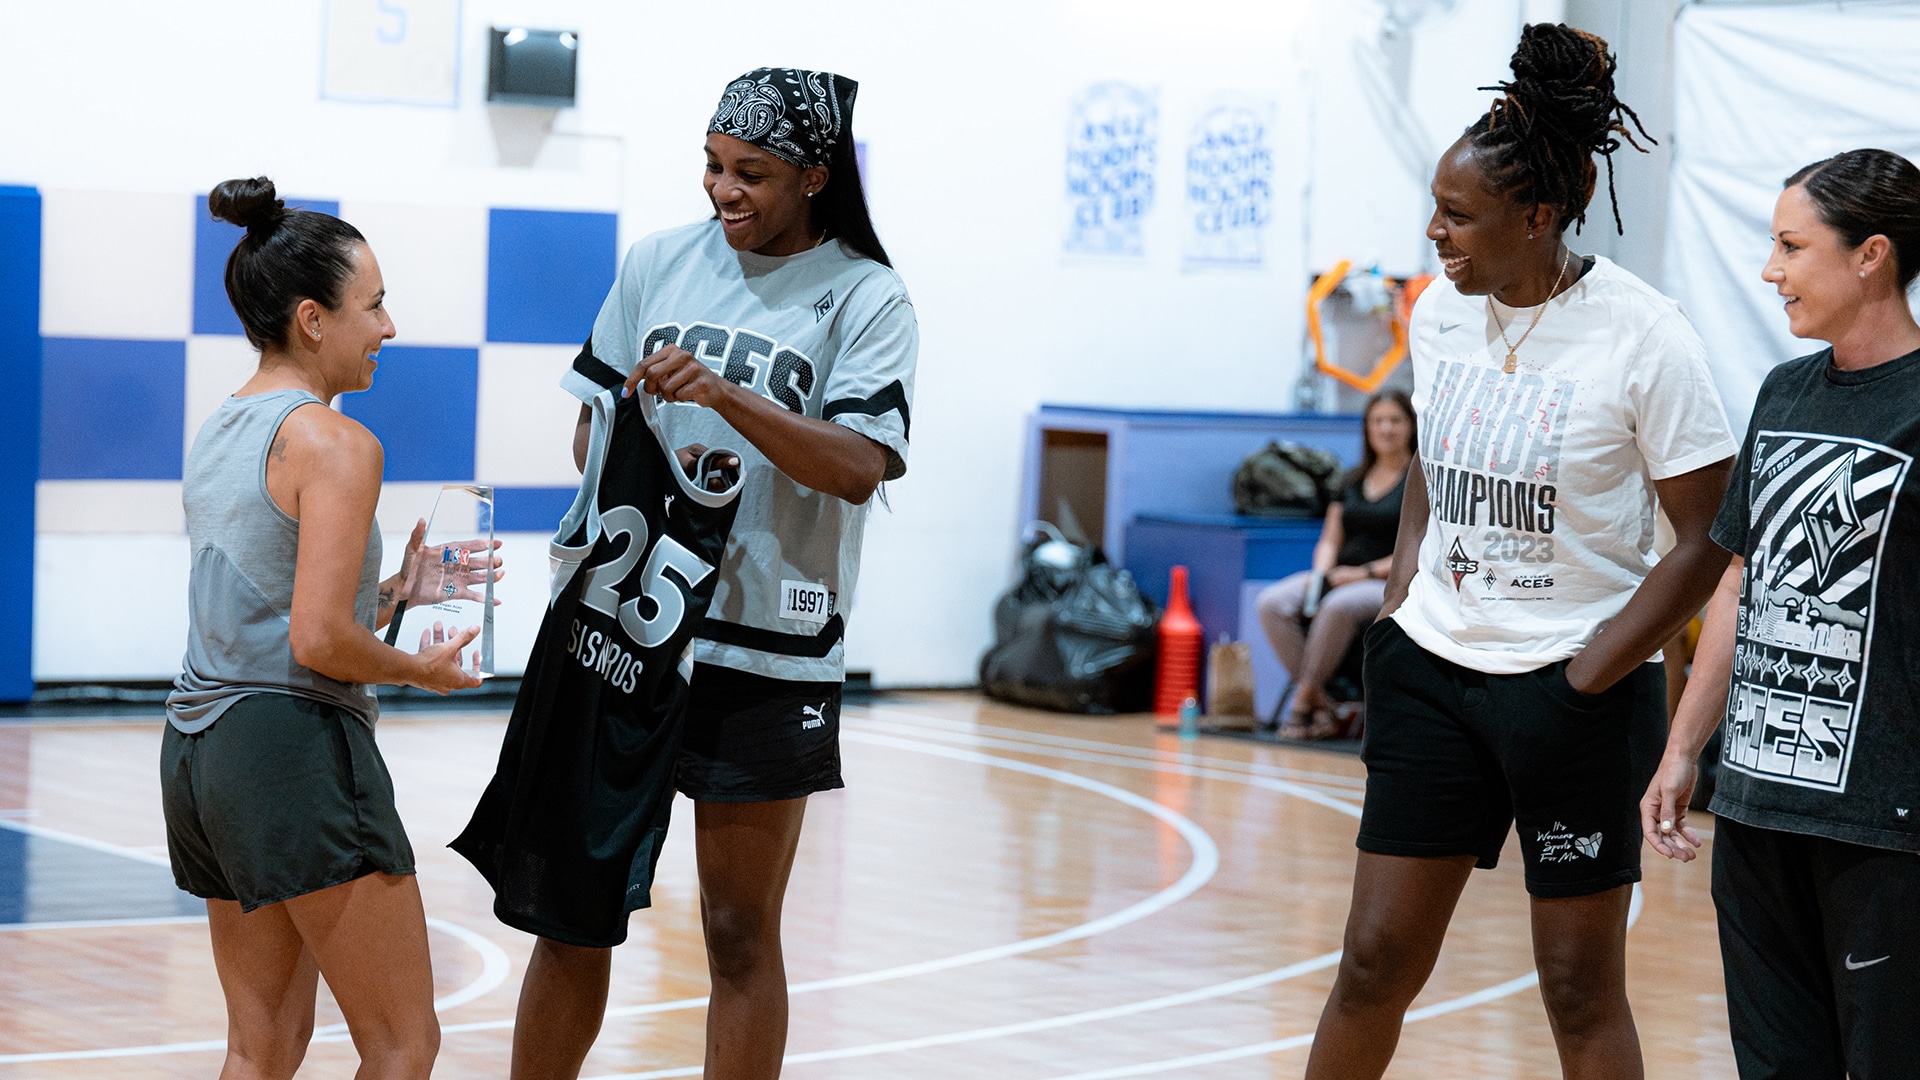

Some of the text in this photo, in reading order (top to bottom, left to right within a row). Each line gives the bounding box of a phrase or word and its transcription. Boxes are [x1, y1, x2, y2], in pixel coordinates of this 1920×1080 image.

[1421, 360, 1576, 482] WNBA
[1421, 459, 1557, 534] HAMPIONS
[1483, 531, 1555, 563] 2023
[579, 504, 716, 648] 25
[1510, 579, 1554, 588] ACES
[791, 588, 825, 614] 1997
[802, 718, 822, 730] PUMA
[1540, 852, 1580, 863] For Me
[1543, 840, 1572, 855] Sports
